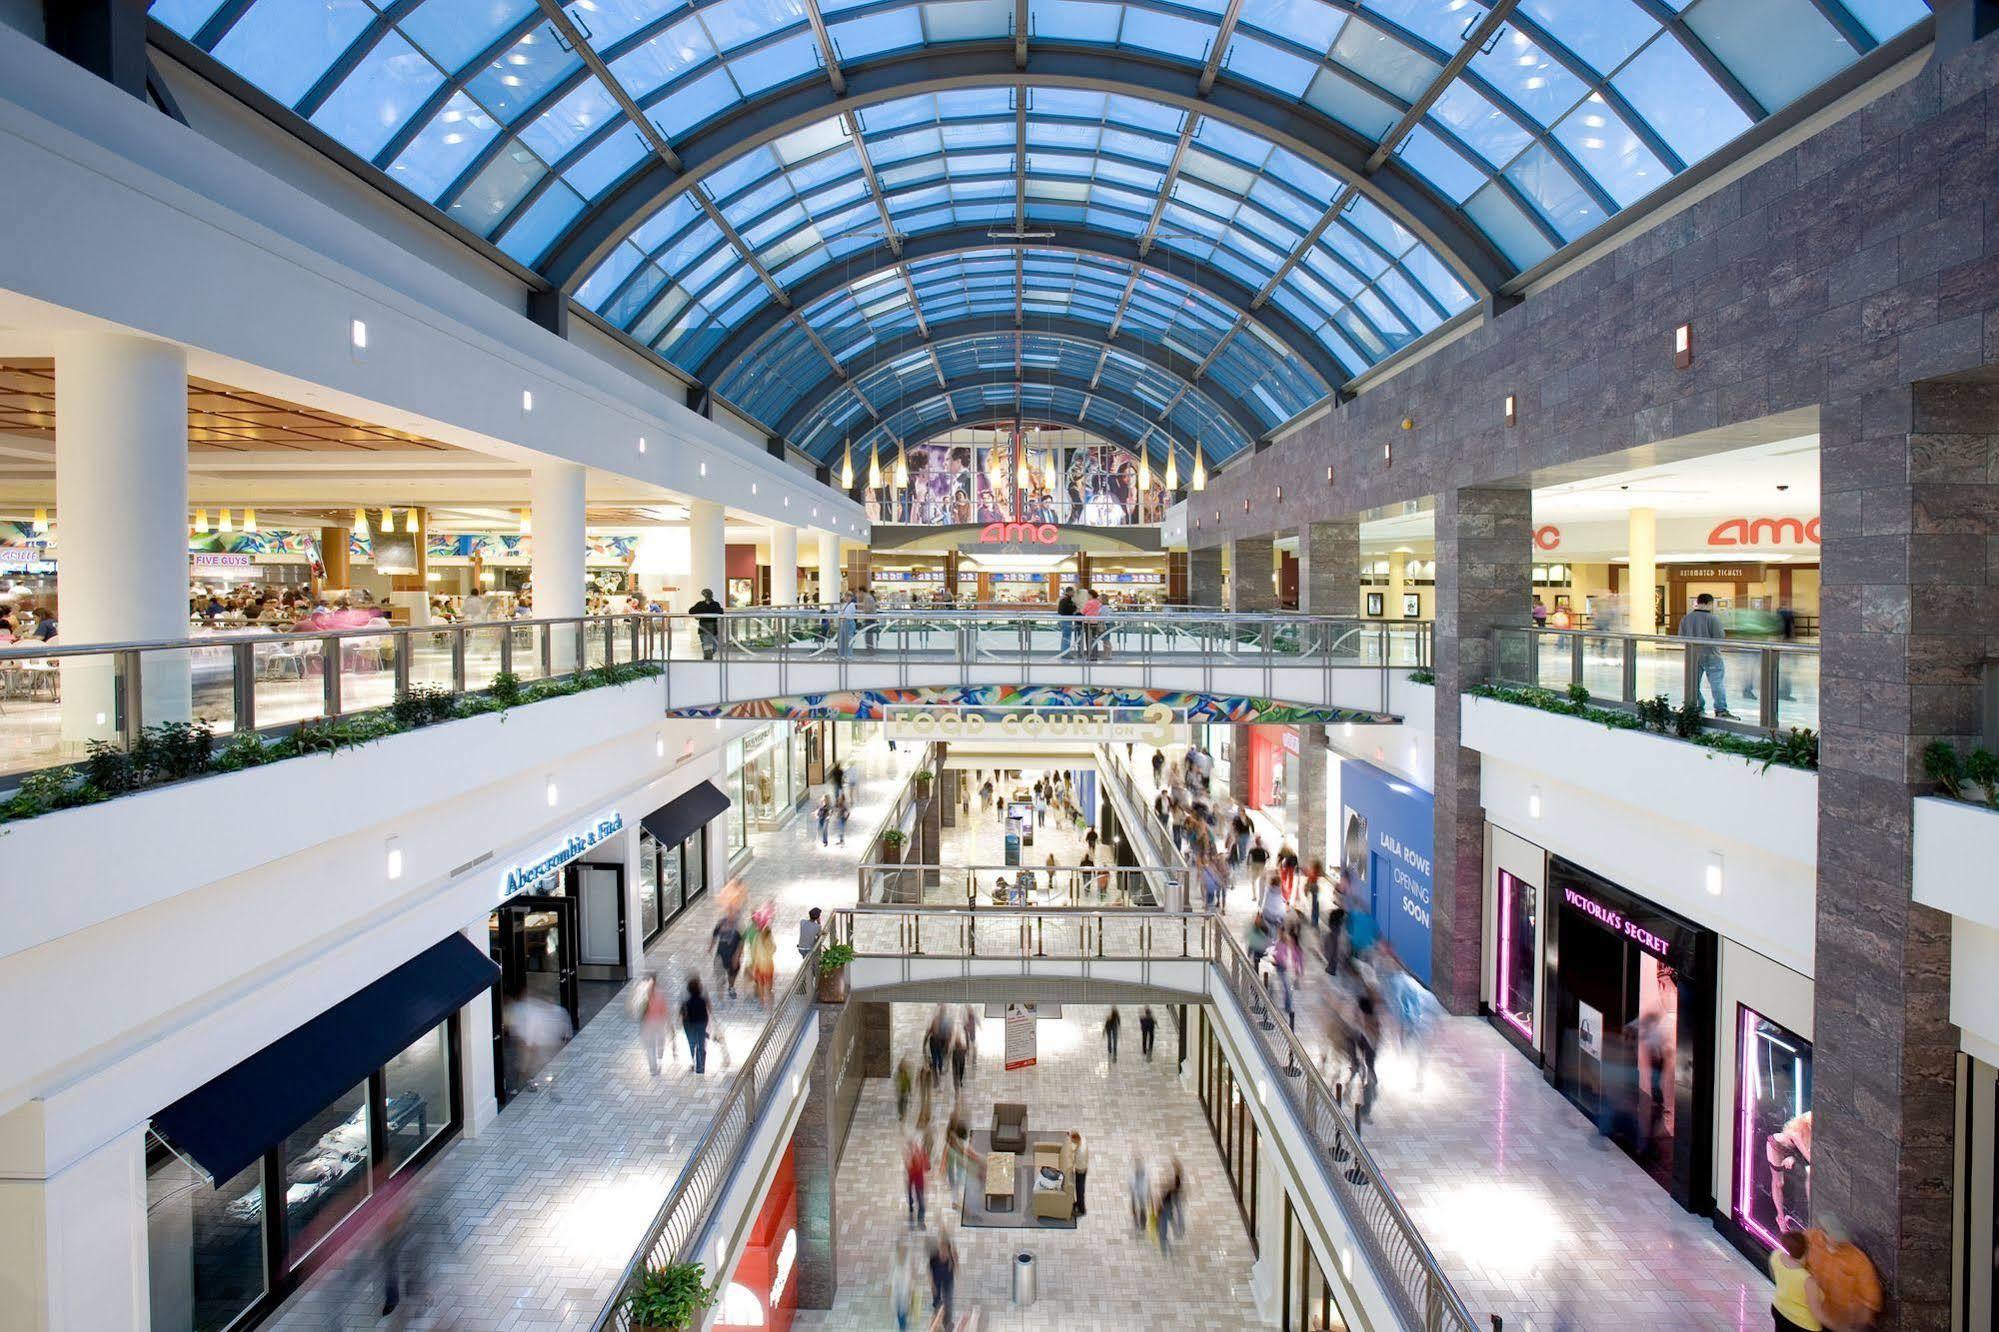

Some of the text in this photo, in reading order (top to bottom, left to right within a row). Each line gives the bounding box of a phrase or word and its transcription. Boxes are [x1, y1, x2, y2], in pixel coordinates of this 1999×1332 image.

[196, 556, 248, 565] FIVE GUYS
[1680, 569, 1743, 577] AUTOMATED TICKETS
[895, 703, 1176, 747] FOOD COURT ON 3
[504, 837, 586, 896] Abercrombie
[598, 812, 623, 841] Fitch
[1380, 831, 1431, 876] LAILA ROWE
[1393, 867, 1430, 904] OPENING
[1402, 895, 1430, 929] SOON
[1564, 888, 1669, 956] VICTORIA'S SECRET
